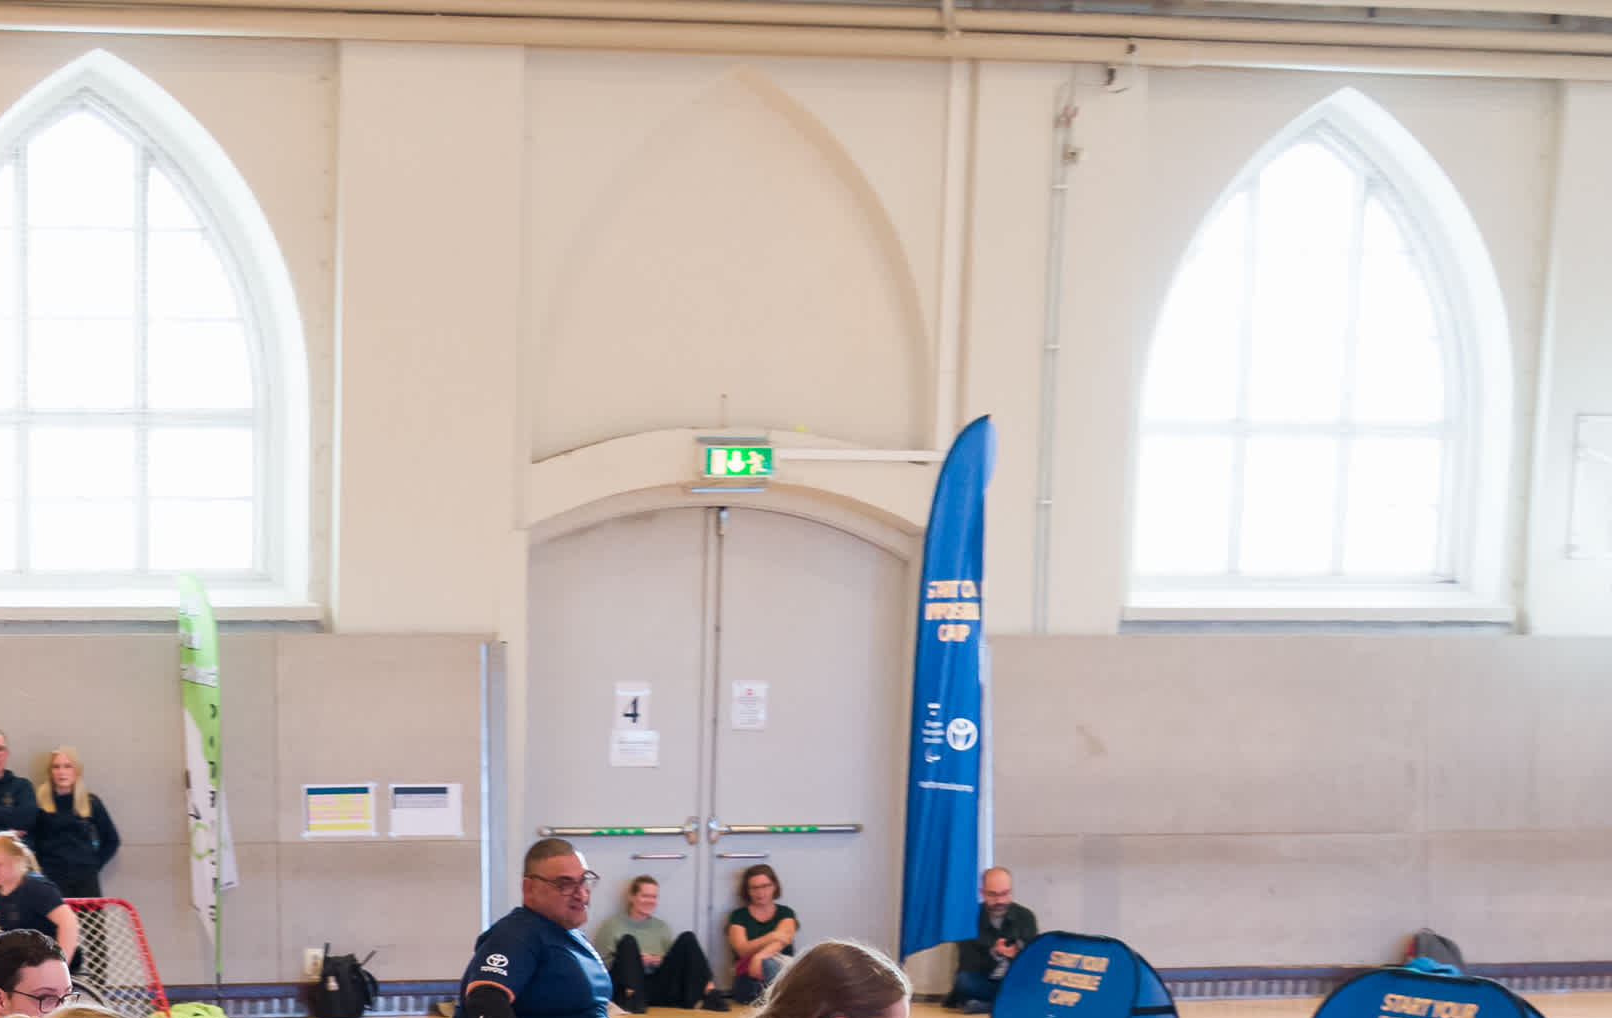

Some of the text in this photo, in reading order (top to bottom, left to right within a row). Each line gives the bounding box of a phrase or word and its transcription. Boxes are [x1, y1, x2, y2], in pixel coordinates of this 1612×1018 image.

[622, 697, 640, 723] 4
[480, 966, 508, 977] TOYOTA
[1380, 993, 1433, 1016] START
